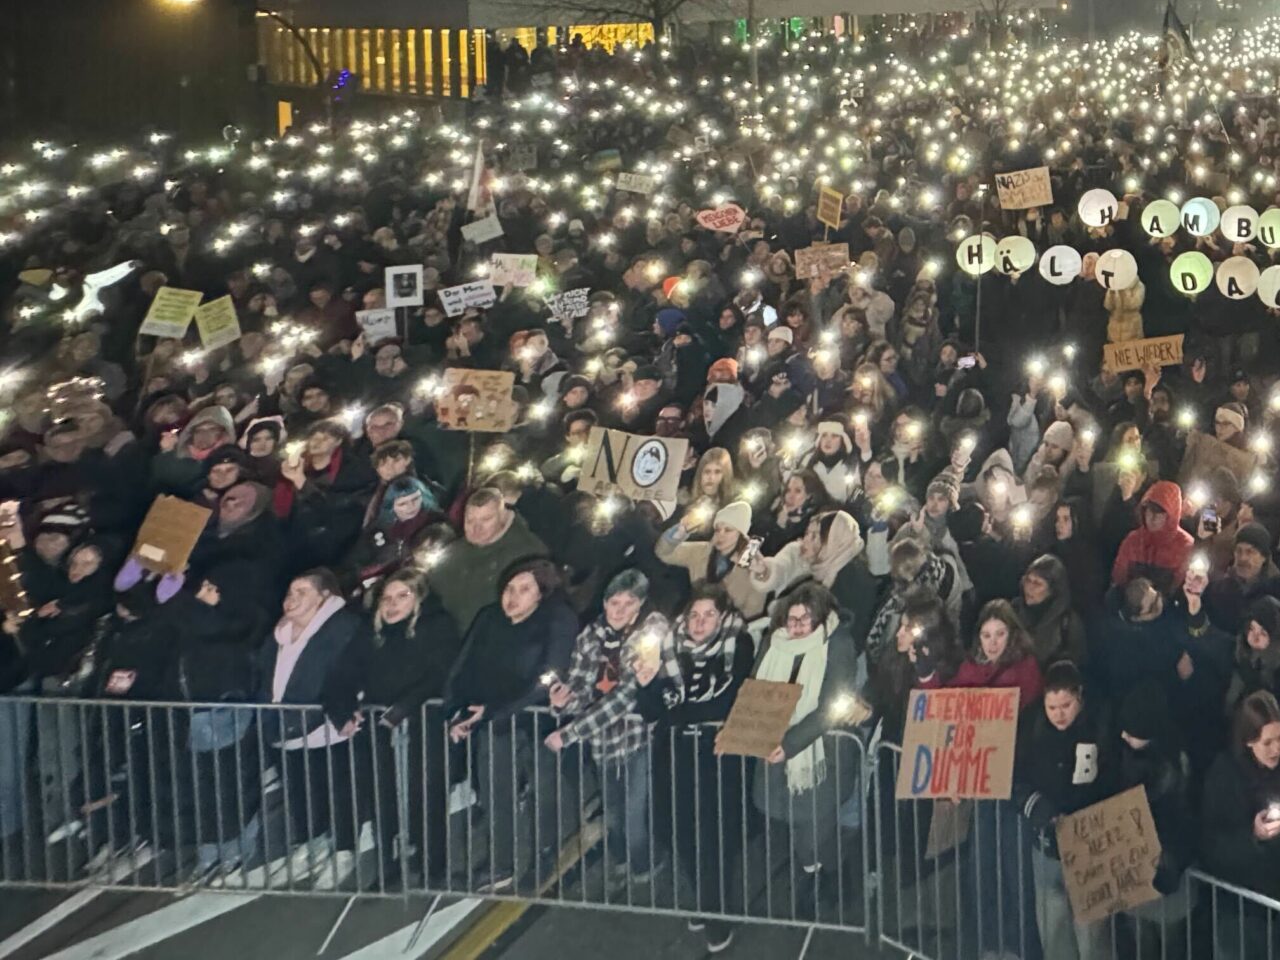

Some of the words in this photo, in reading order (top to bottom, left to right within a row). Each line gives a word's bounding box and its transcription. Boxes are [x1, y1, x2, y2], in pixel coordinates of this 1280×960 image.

[968, 244, 1114, 290] HÄLT
[1114, 348, 1133, 366] NIE
[913, 692, 1016, 722] ALTERNATIVE
[911, 744, 998, 795] DUMME
